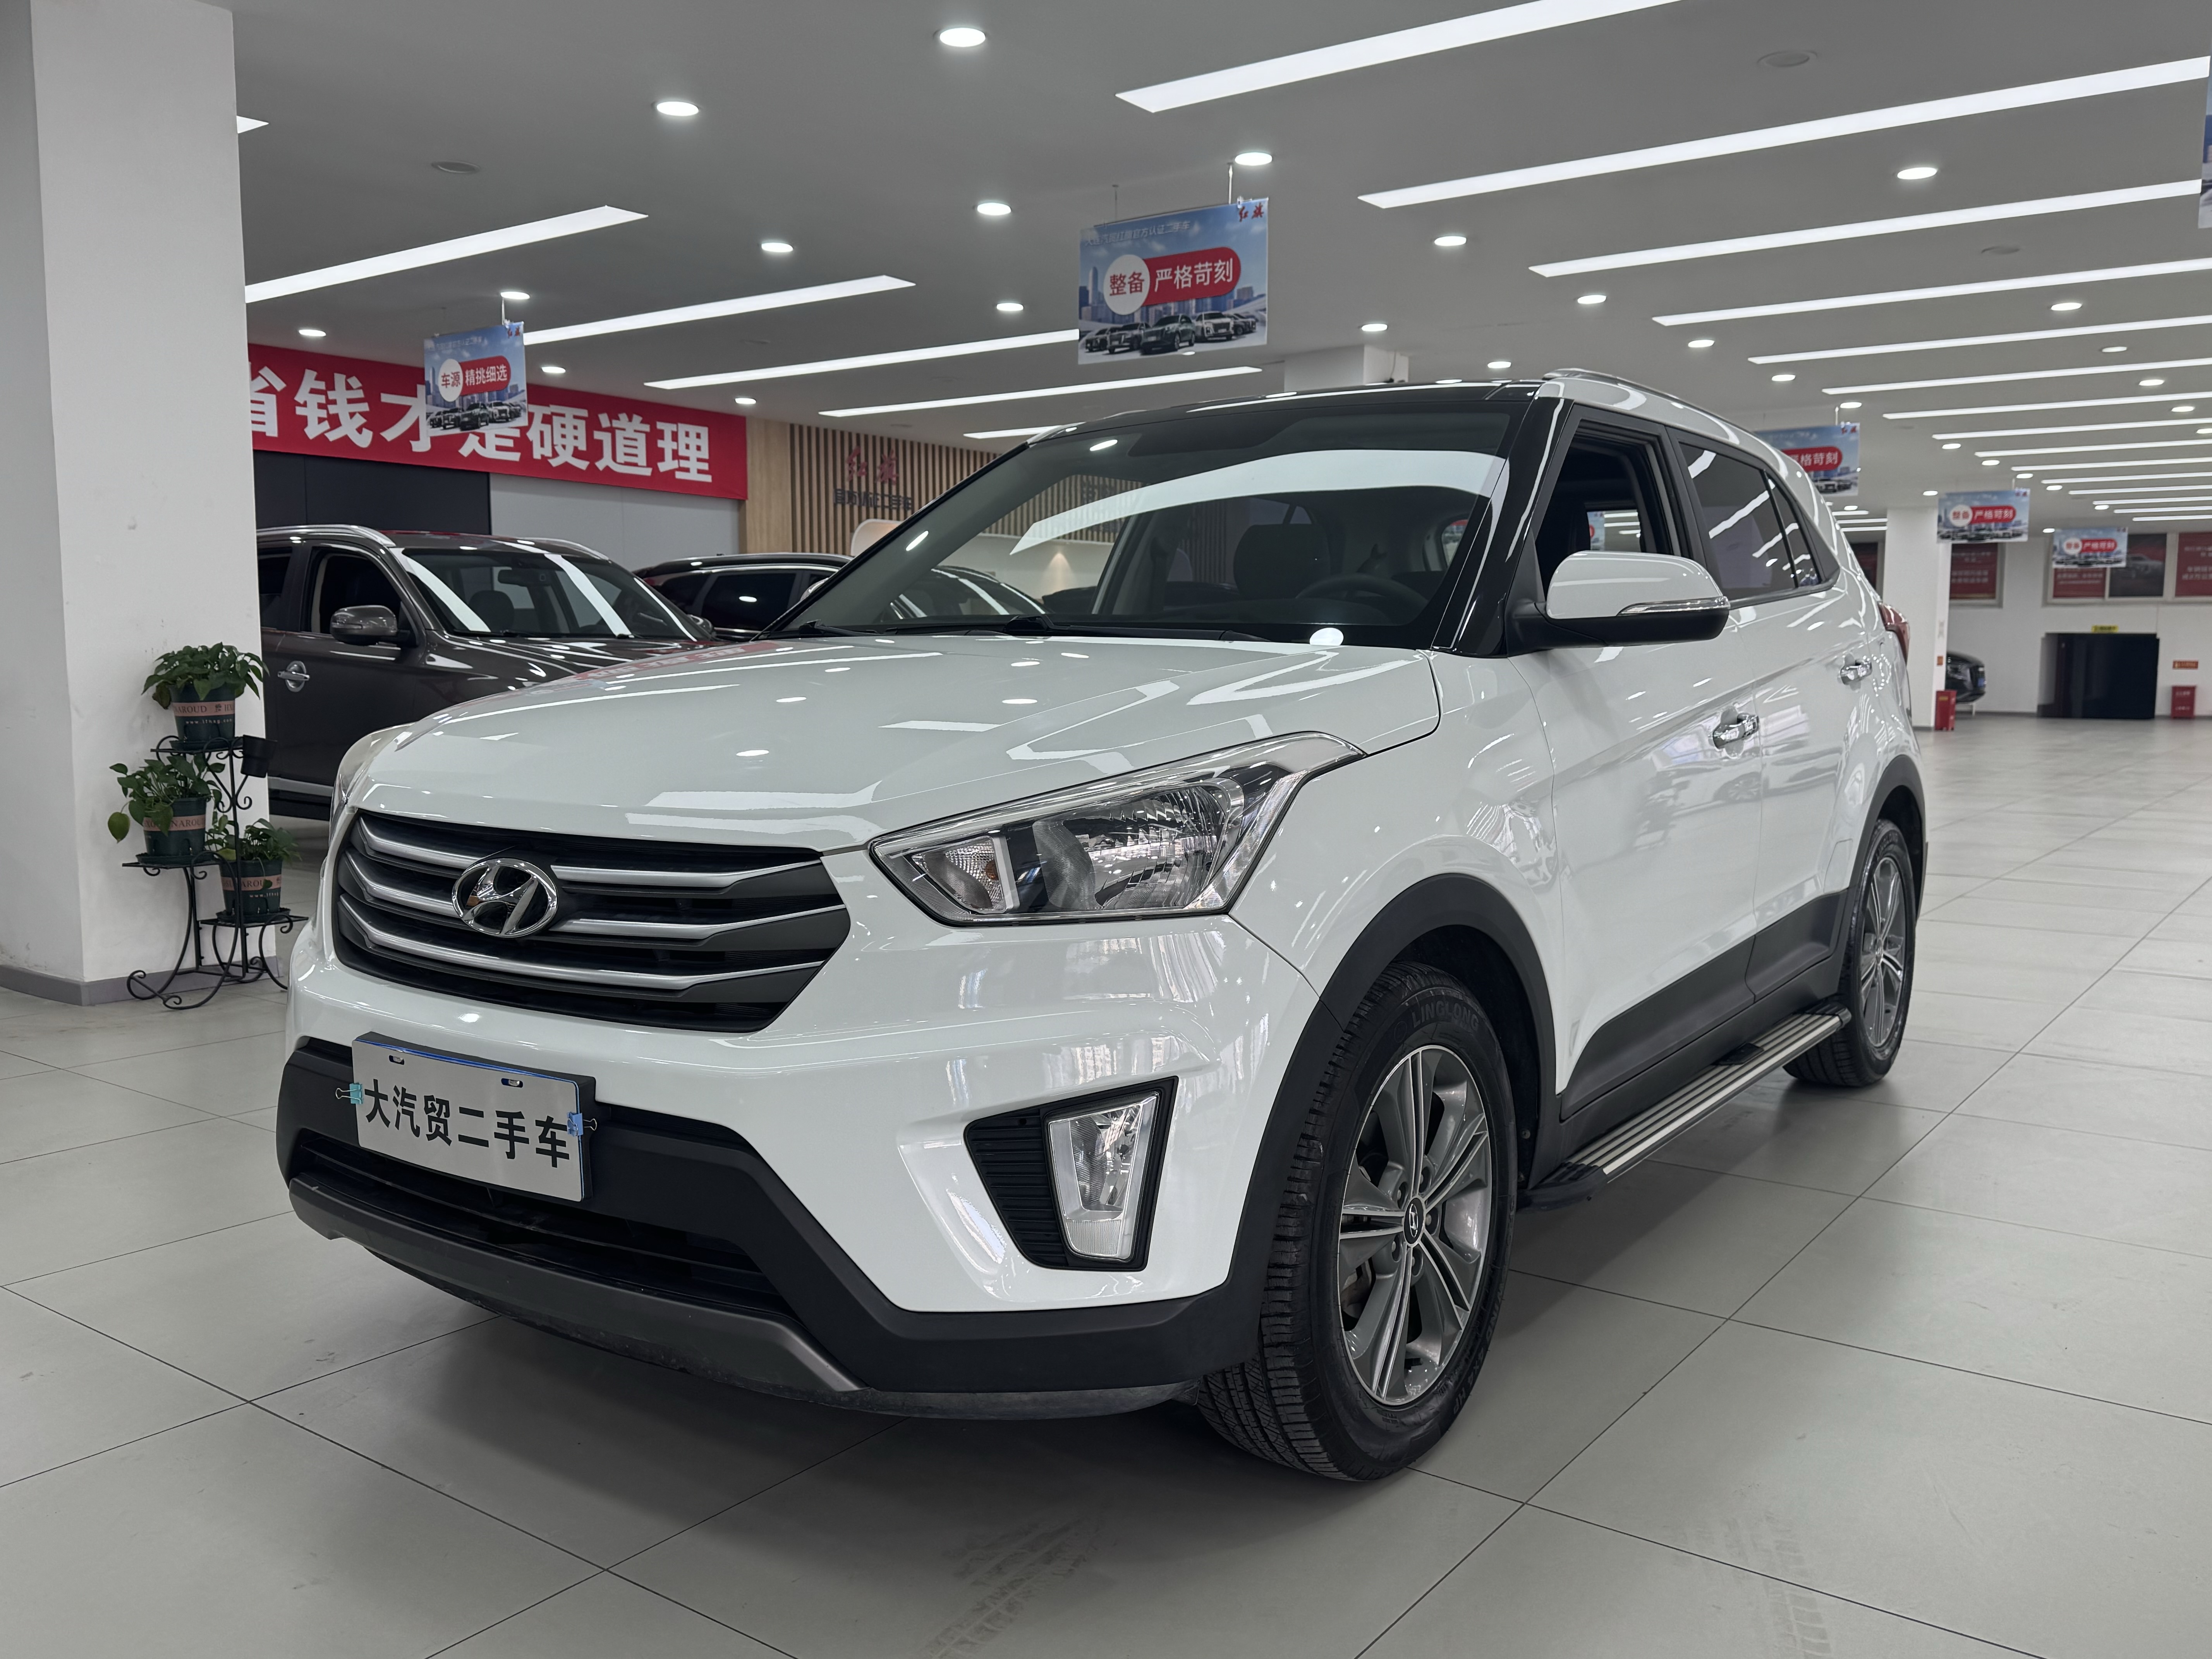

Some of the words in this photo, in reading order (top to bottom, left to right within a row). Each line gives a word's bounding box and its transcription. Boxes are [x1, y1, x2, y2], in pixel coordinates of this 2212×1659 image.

[1109, 271, 1145, 297] 整备
[1154, 258, 1233, 292] 严格苛刻
[441, 371, 461, 388] 车源
[465, 364, 507, 386] 精挑细选
[1412, 1000, 1479, 1031] LINGLONG
[364, 1079, 570, 1168] 大汽贸二手车
